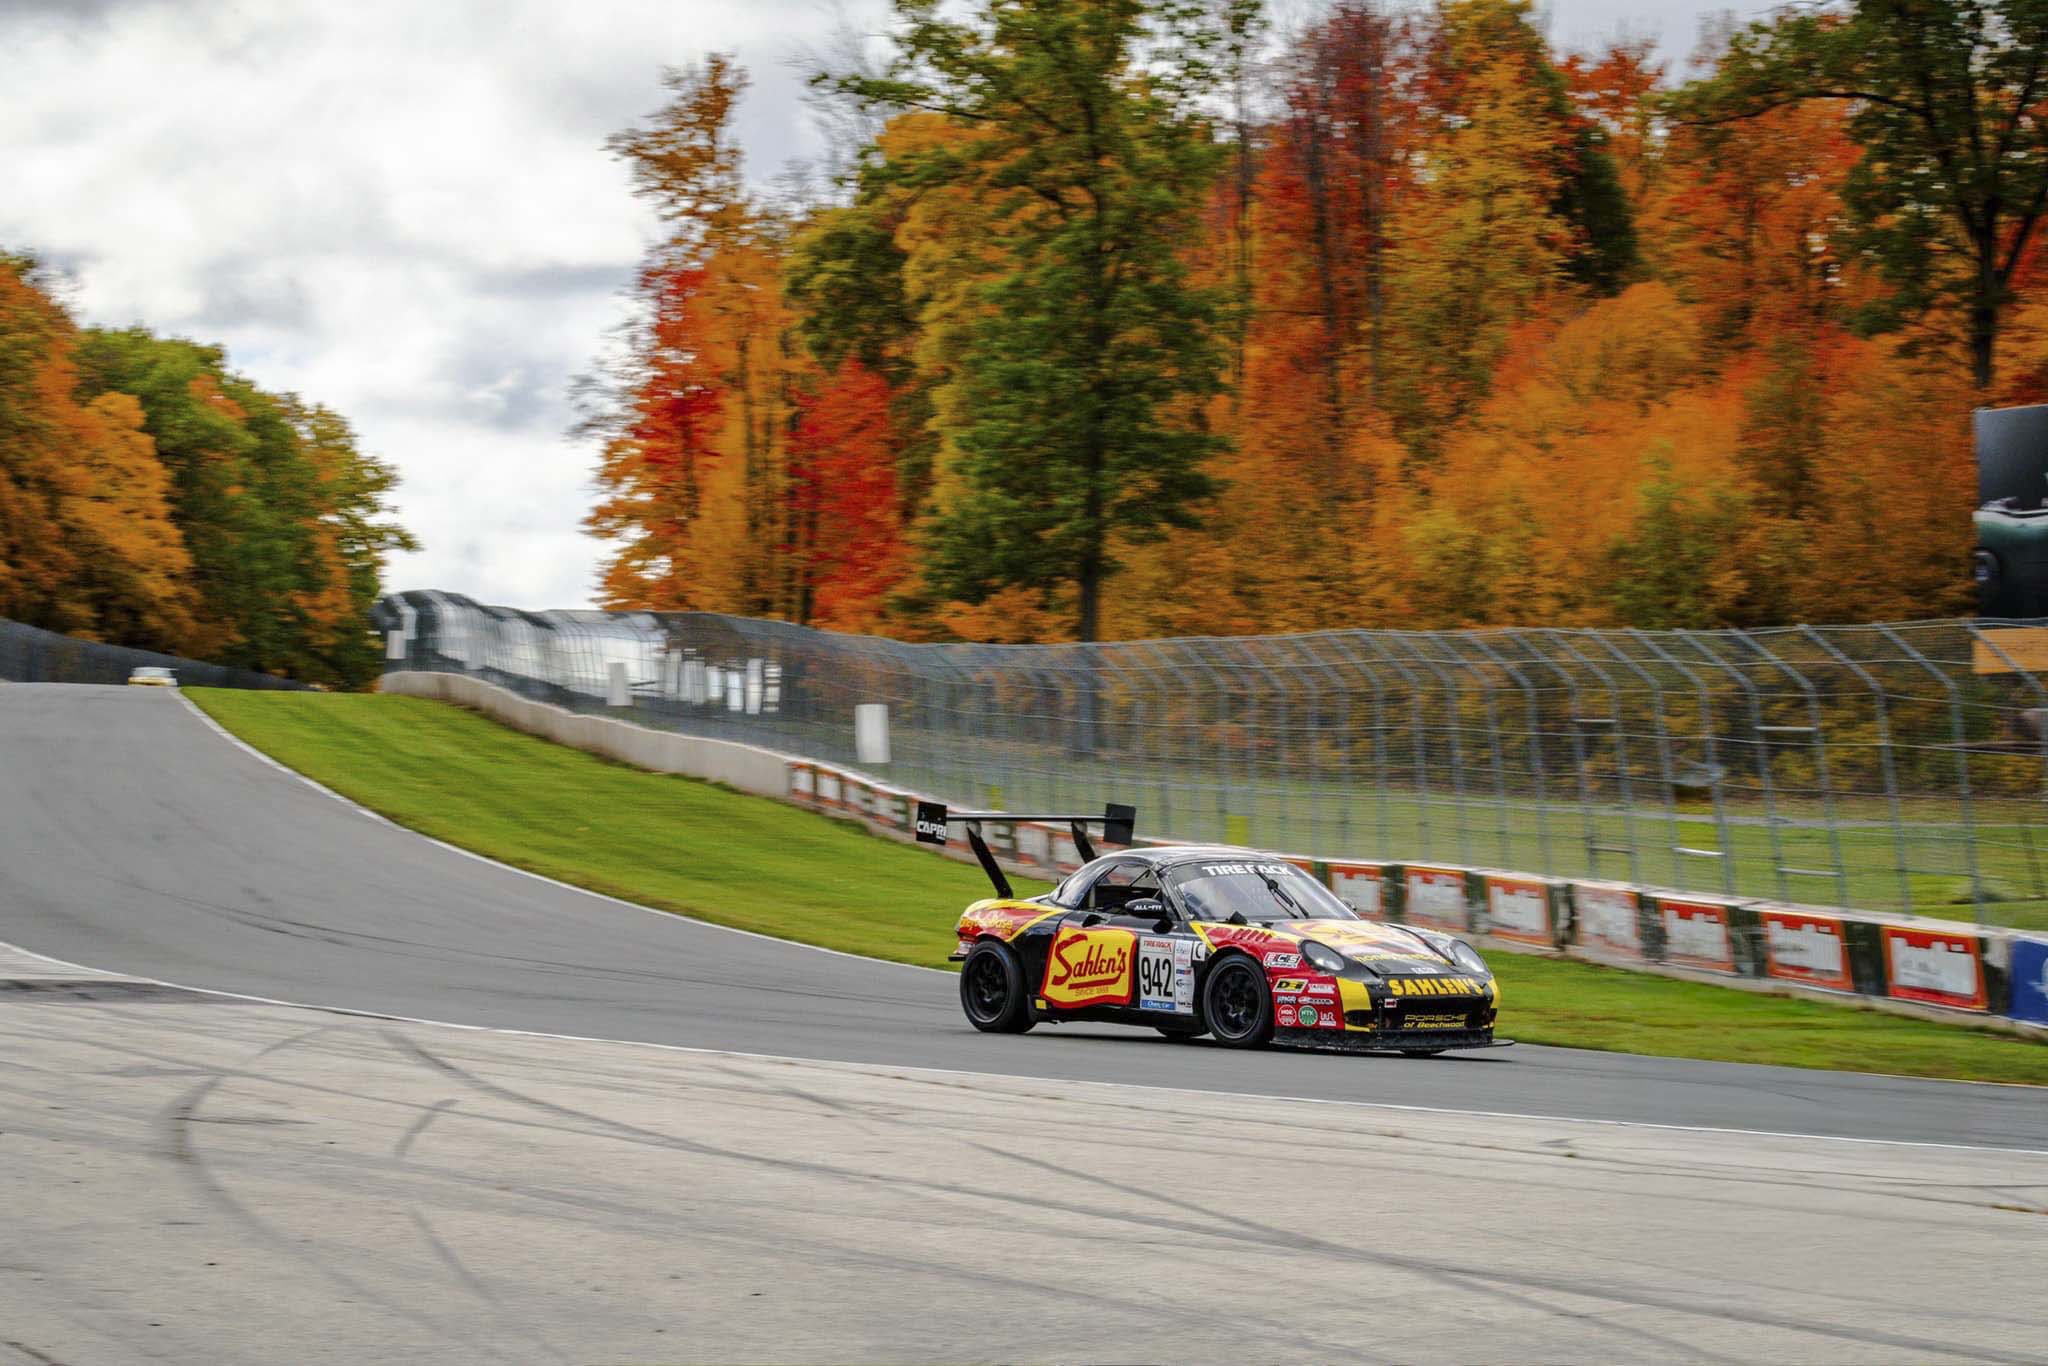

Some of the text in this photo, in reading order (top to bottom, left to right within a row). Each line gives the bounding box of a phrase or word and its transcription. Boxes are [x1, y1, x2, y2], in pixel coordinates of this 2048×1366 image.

[1051, 933, 1127, 986] Sahlen's
[1141, 956, 1173, 997] 942
[1388, 978, 1485, 996] SAHLEN'S
